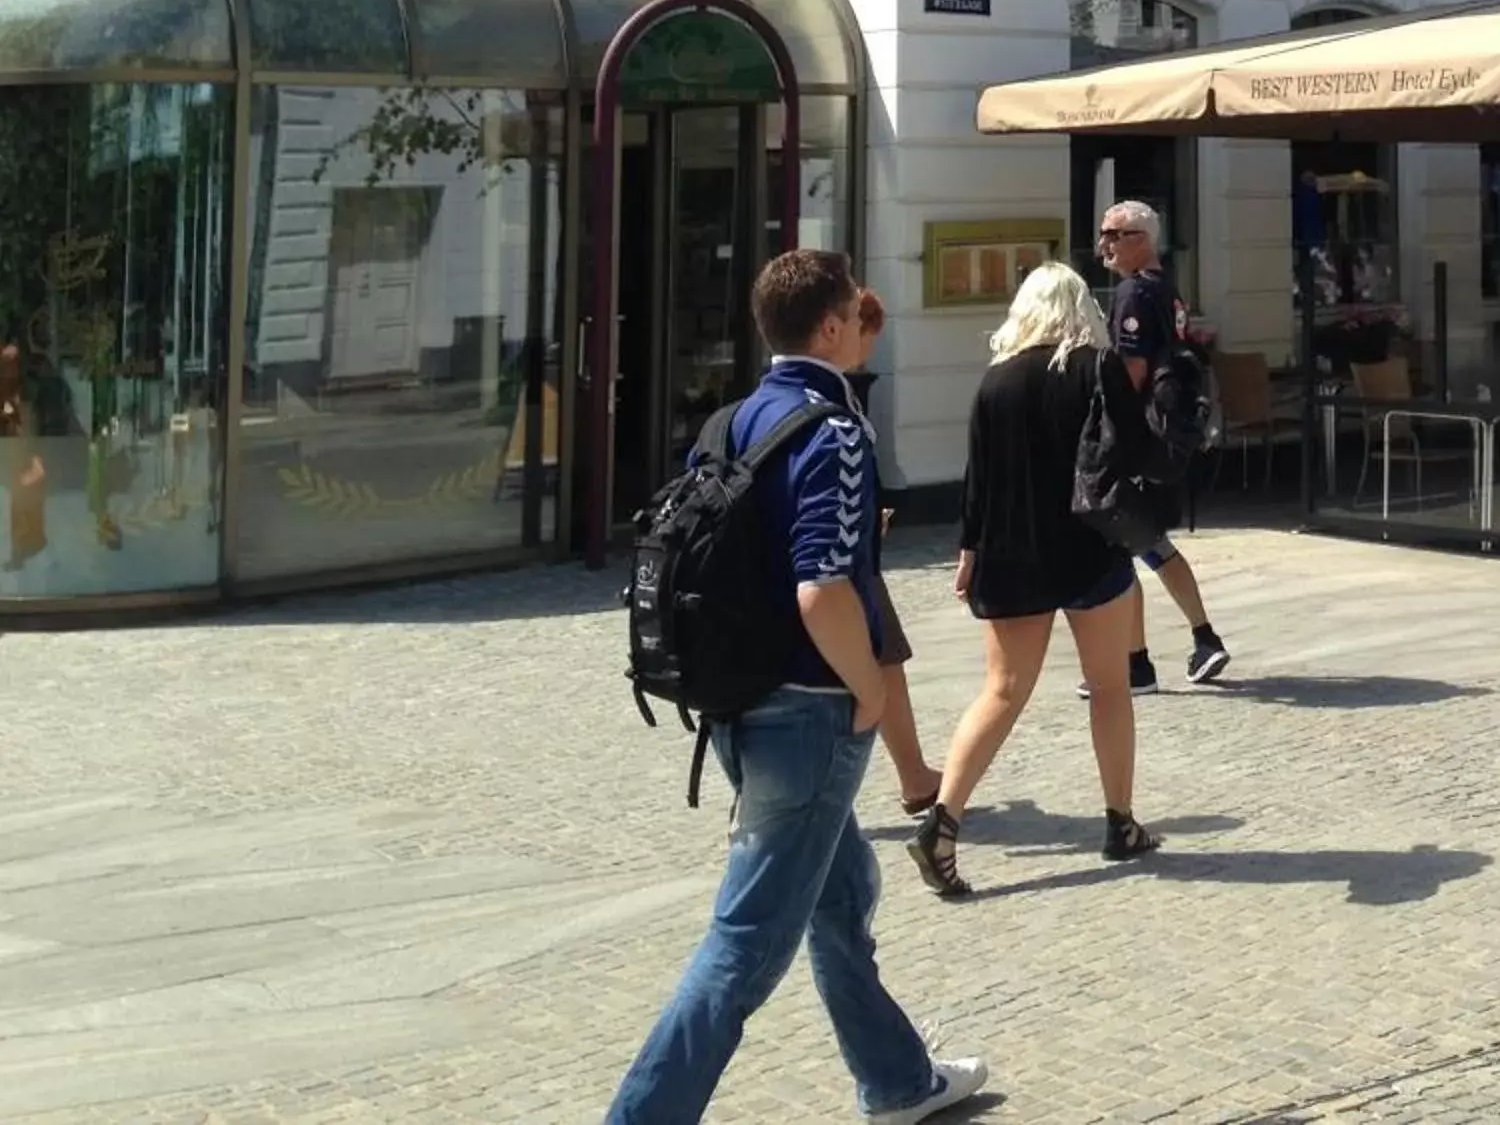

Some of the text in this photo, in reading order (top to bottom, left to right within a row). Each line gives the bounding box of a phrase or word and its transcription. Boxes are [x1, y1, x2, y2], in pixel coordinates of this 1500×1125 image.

[1250, 67, 1480, 99] BEST WESTERN Hotel Eyde
